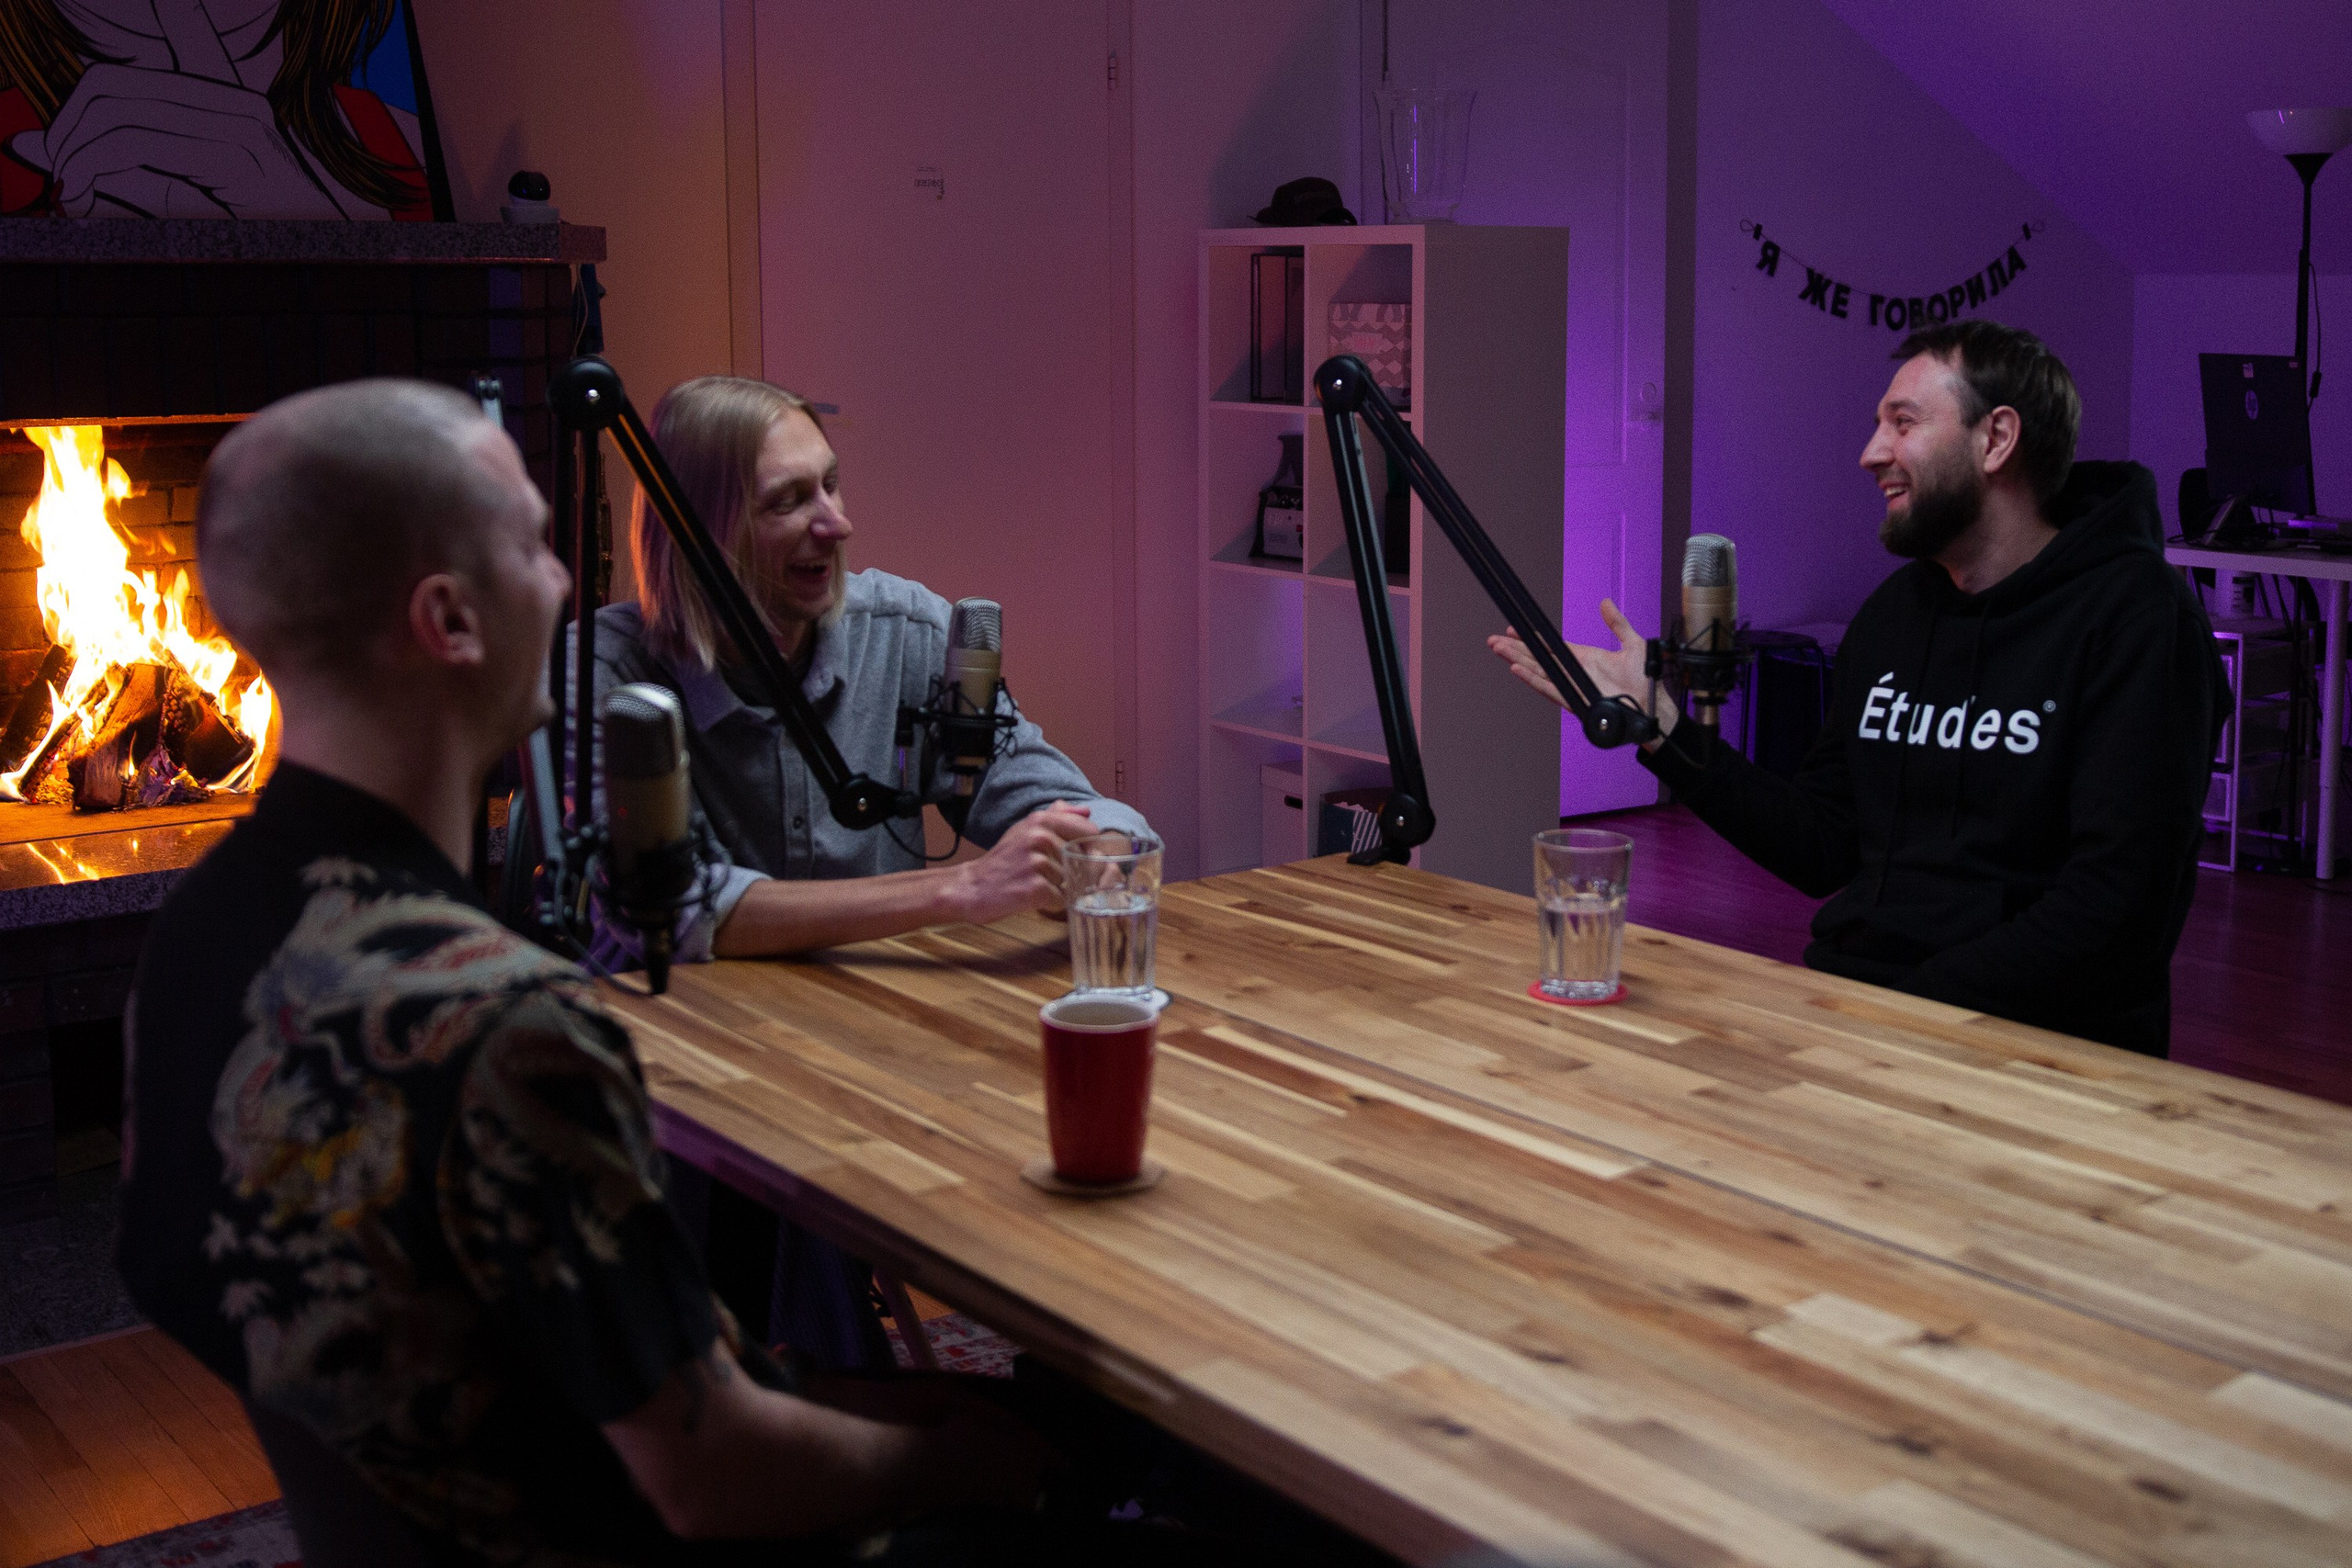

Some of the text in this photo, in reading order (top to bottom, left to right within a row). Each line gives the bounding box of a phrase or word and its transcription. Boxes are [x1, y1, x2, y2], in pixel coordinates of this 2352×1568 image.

[1756, 240, 2027, 331] Я ЖЕ ГОВОРИЛА
